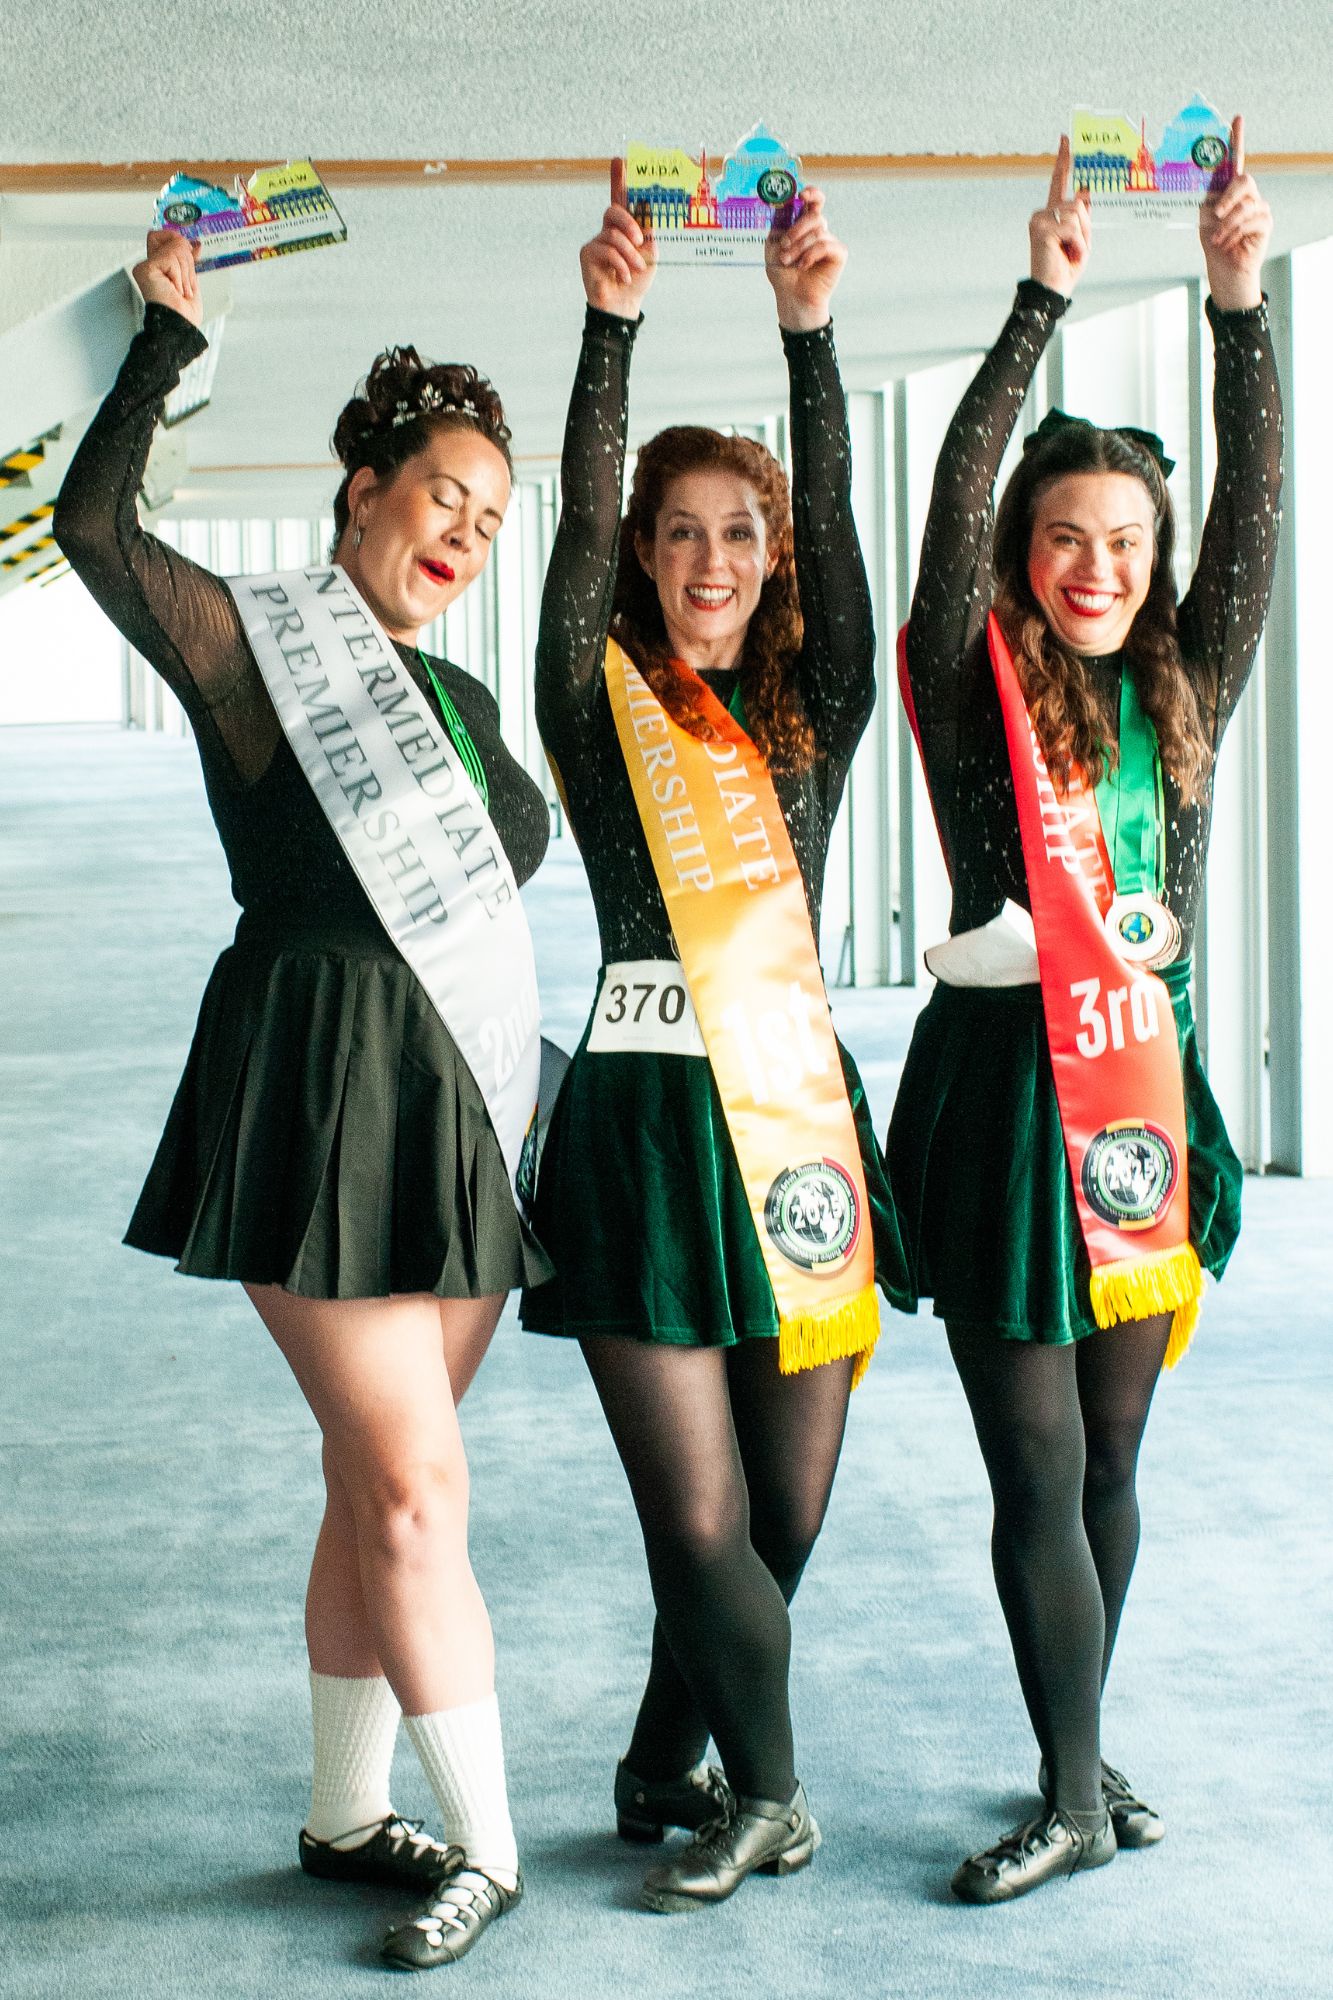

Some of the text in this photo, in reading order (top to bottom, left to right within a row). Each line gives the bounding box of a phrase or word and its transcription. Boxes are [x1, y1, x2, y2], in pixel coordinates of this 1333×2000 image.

[636, 164, 680, 177] W.I.D.A
[250, 583, 449, 929] PREMIERSHIP
[303, 569, 512, 920] NTERMEDIATE
[605, 983, 686, 1024] 370
[720, 981, 829, 1105] 1st
[790, 1196, 843, 1230] 2025
